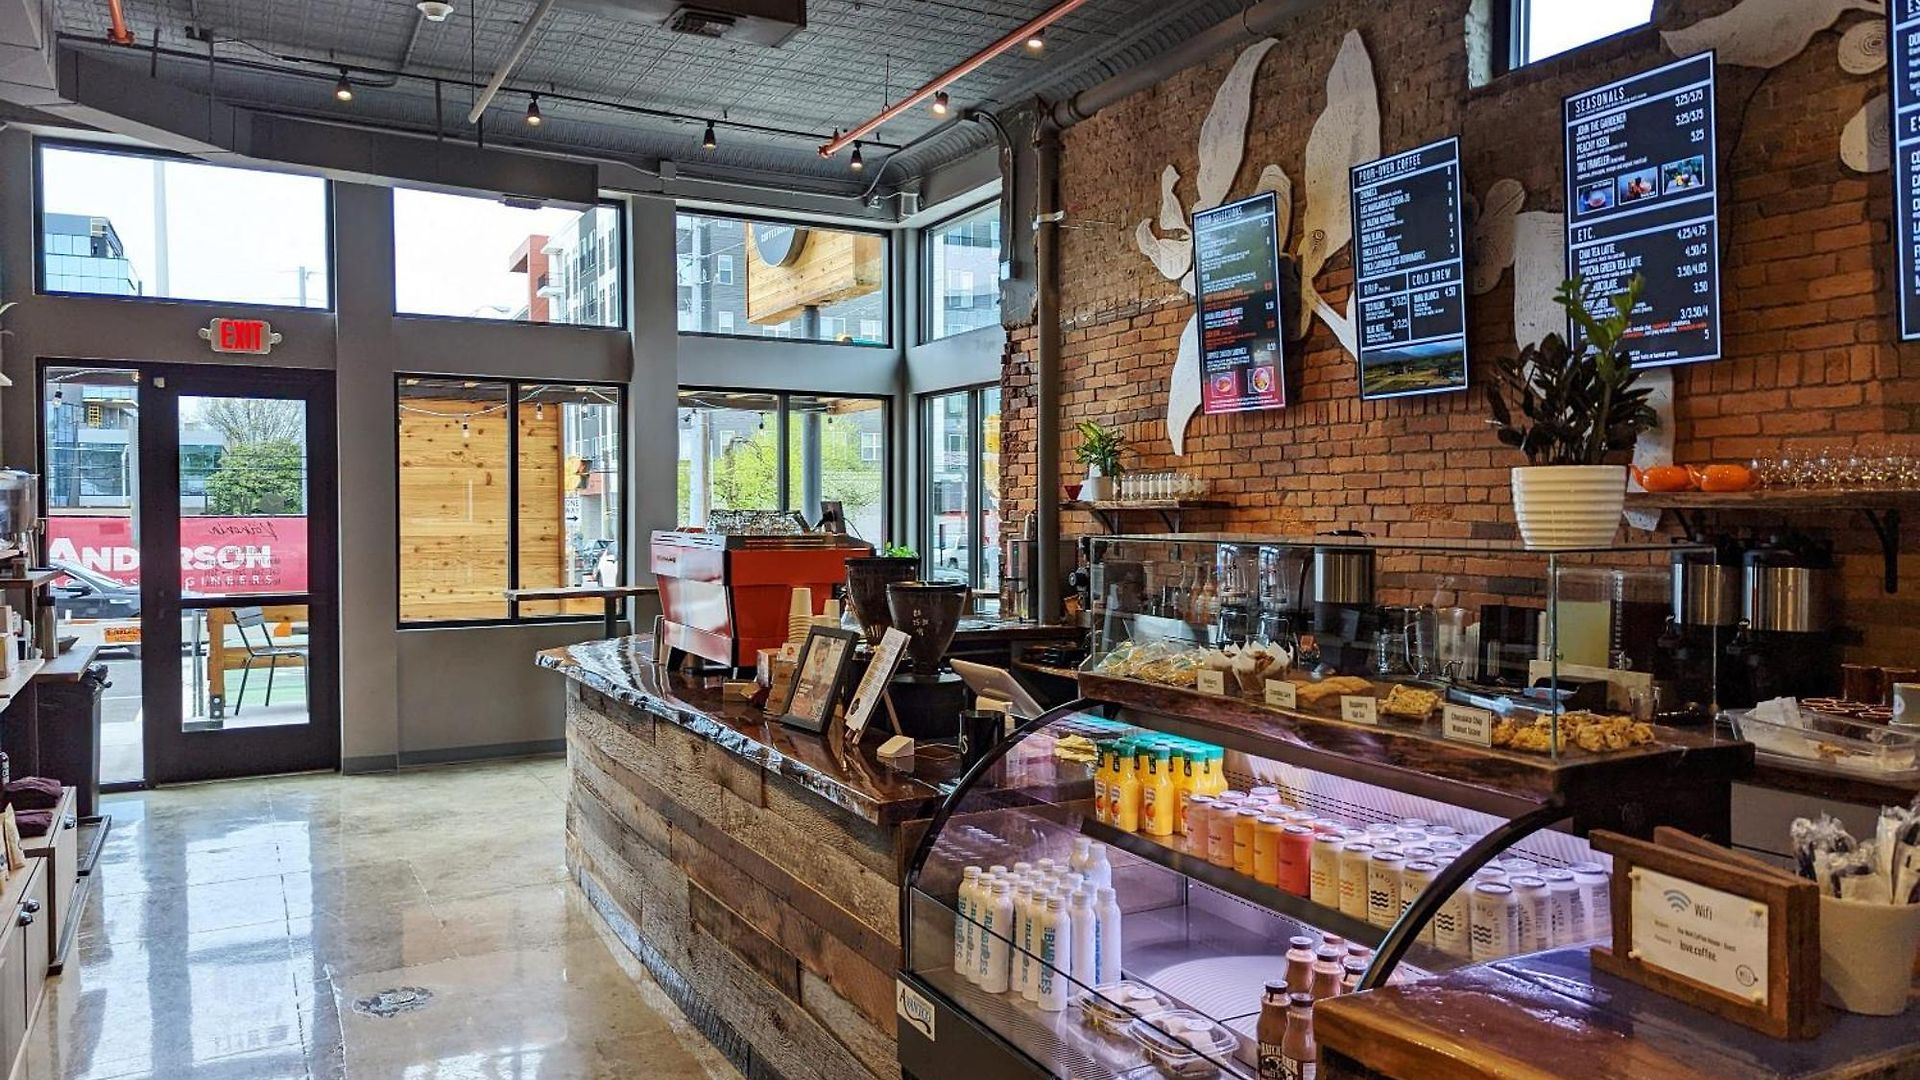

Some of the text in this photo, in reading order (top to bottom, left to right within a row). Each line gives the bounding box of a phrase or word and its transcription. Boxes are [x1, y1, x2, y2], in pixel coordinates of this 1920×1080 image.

[1575, 87, 1625, 113] SEASONALS
[1397, 154, 1421, 170] COFFEE
[1577, 227, 1596, 242] ETC.
[1412, 268, 1451, 286] COLD BREW
[221, 321, 264, 351] EXIT
[1704, 330, 1710, 340] 5
[1694, 904, 1713, 921] Wifi
